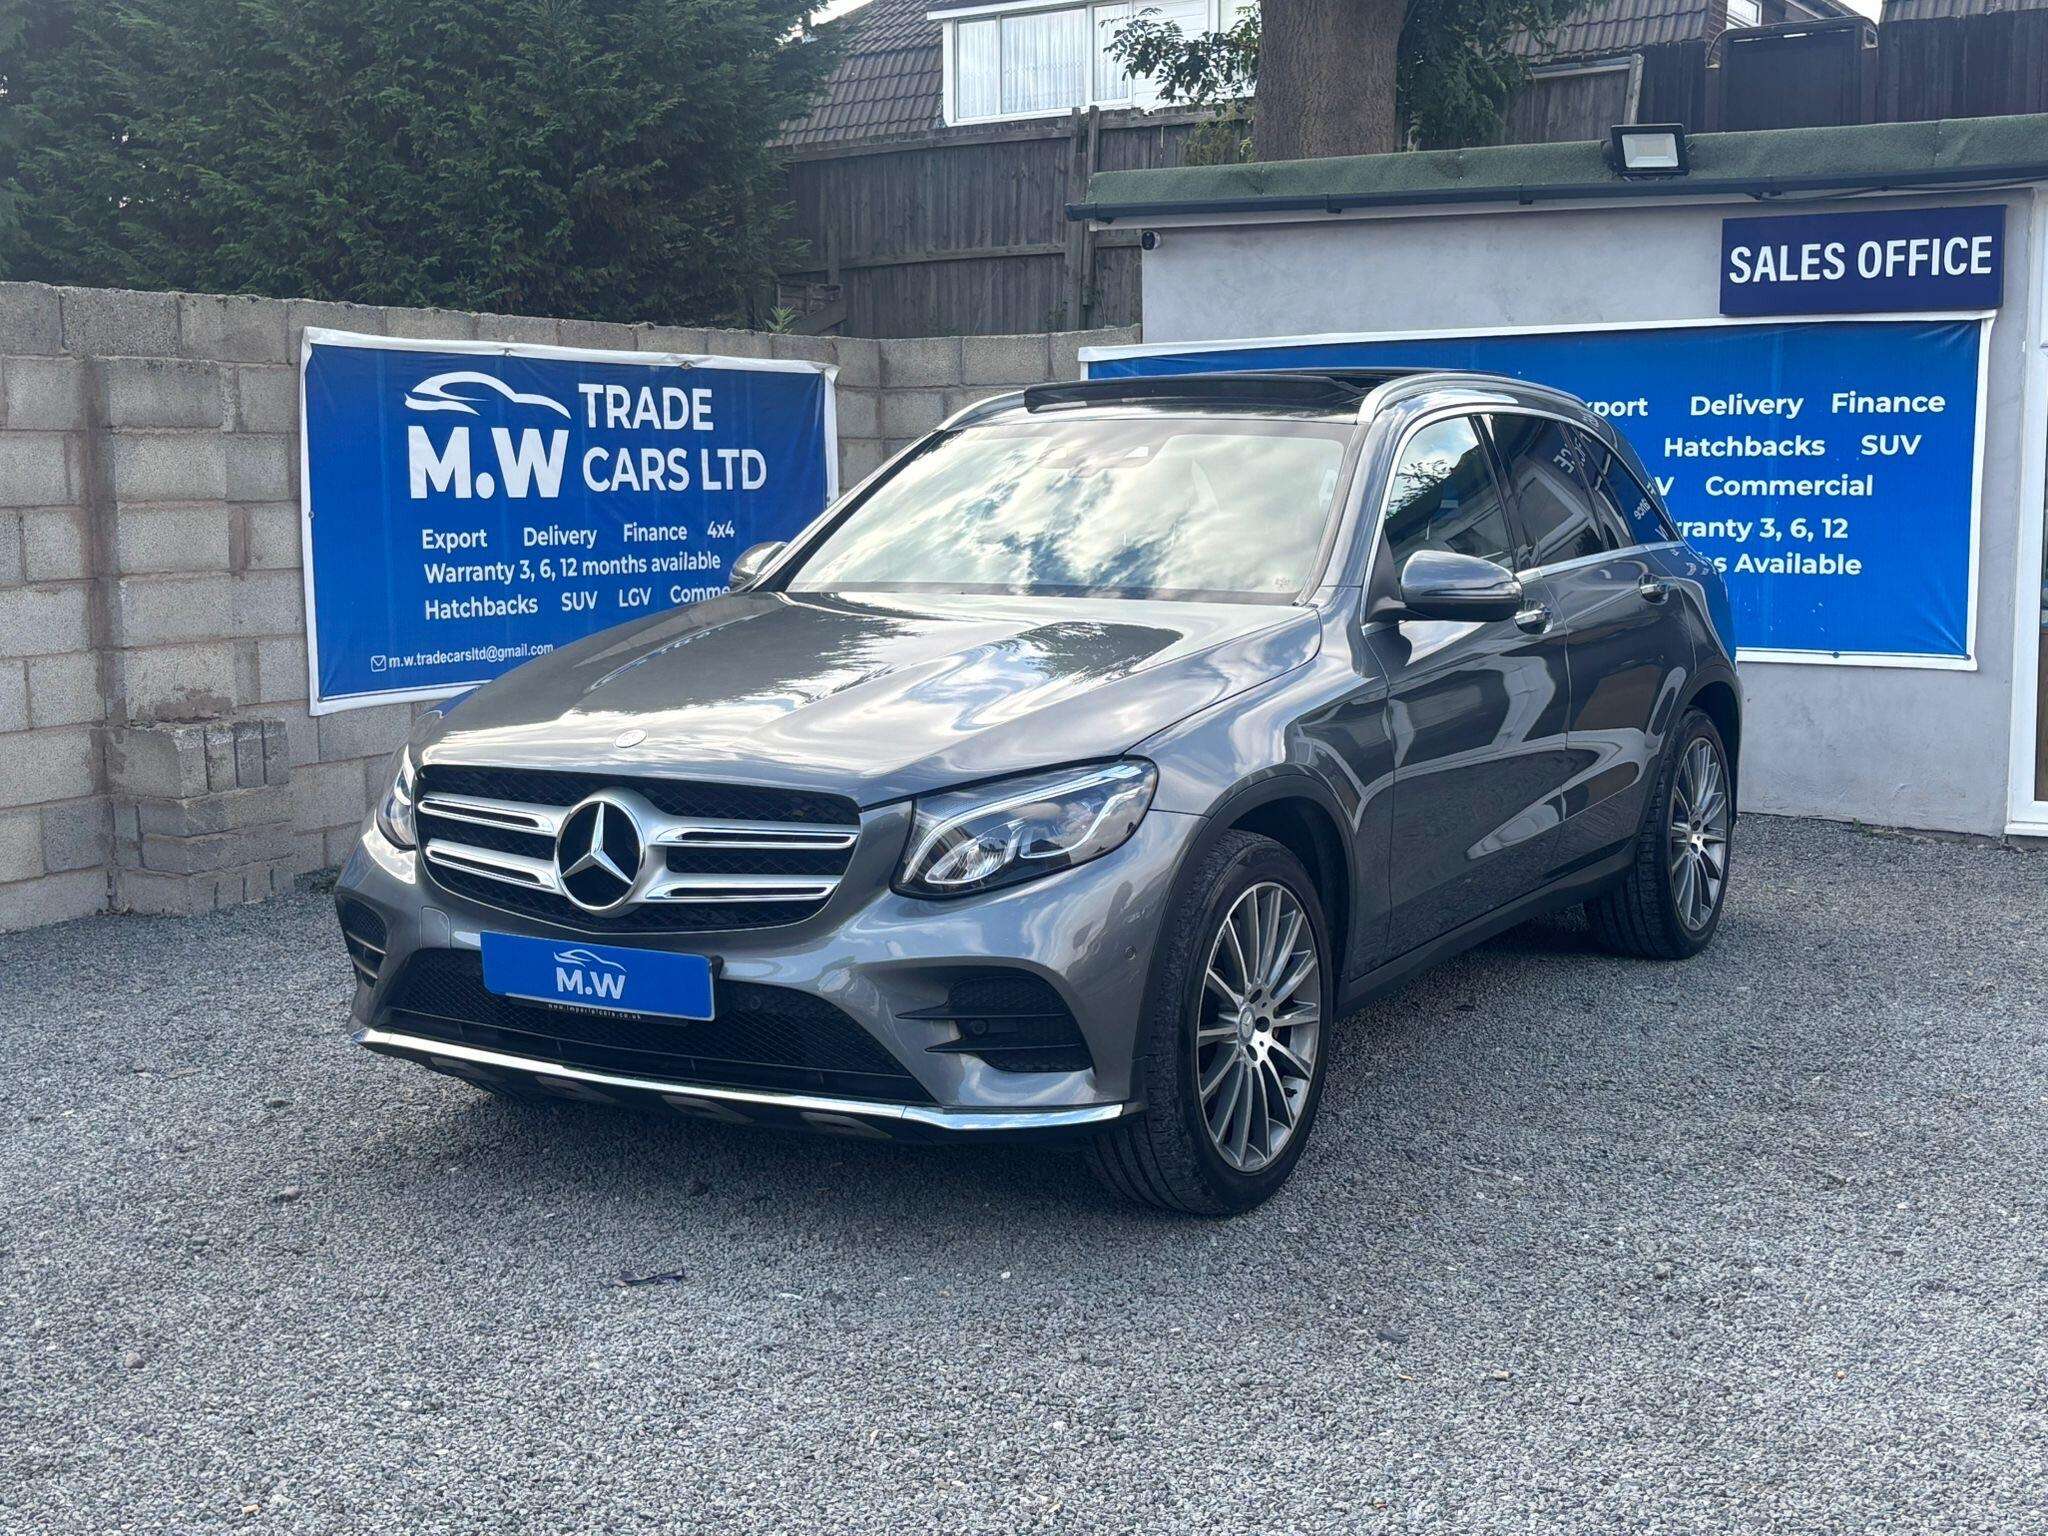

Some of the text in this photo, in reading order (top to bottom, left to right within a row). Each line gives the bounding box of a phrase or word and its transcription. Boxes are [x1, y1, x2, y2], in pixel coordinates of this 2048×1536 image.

[1730, 236, 1992, 283] SALES OFFICE
[579, 384, 713, 430] TRADE
[1691, 394, 1803, 419] Delivery
[1832, 391, 1945, 413] Finance
[1665, 435, 1921, 456] Hatchbacks SUV
[408, 426, 569, 498] M.W
[583, 447, 766, 491] CARS LTD
[1706, 474, 1872, 495] Commercial
[423, 521, 734, 553] Export Delivery Finance 4x4
[1760, 518, 1781, 541] 3,
[1791, 518, 1813, 541] 6,
[1822, 518, 1847, 538] 12
[424, 551, 720, 584] Warranty 3, 6, 12 months available
[1735, 552, 1861, 574] Available
[426, 595, 538, 619] Hatchbacks
[562, 592, 597, 611] SUV
[620, 588, 651, 606] LGV
[557, 967, 625, 998] M.W
